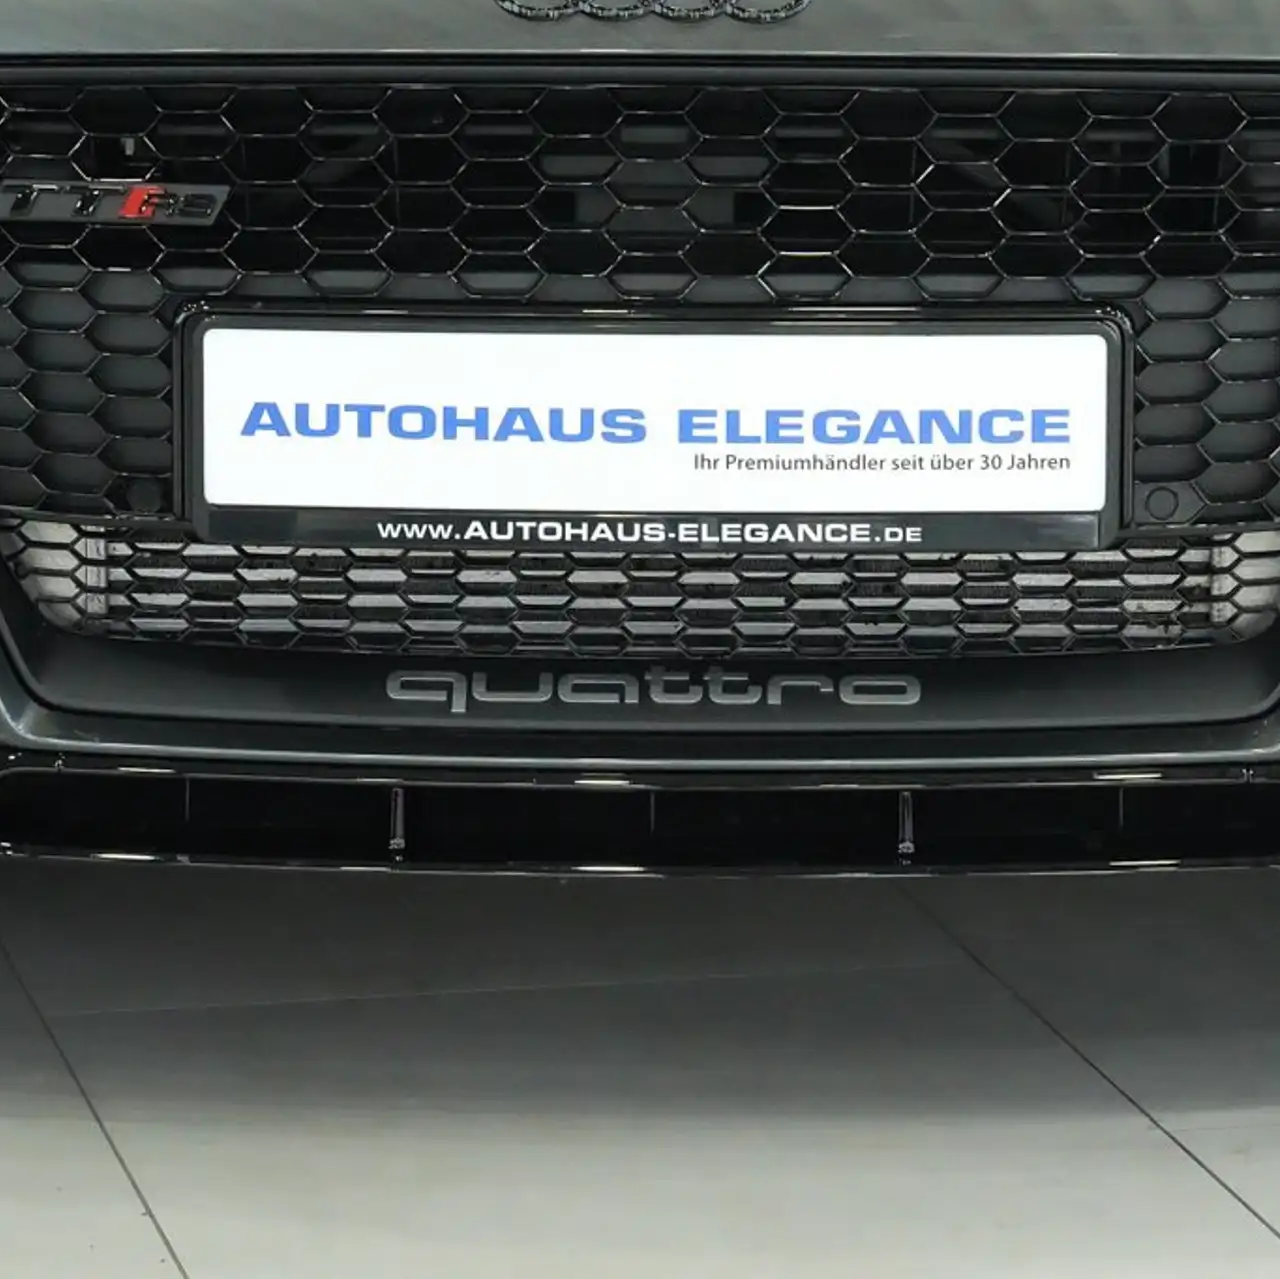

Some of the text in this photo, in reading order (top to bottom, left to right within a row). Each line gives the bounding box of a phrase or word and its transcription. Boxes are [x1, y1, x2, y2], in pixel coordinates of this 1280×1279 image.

[240, 401, 1070, 444] AUTOHAUS ELEGANCE
[693, 453, 1070, 472] Ihr Premiumhändler seit über 30 Jahren
[386, 666, 921, 713] quattro
